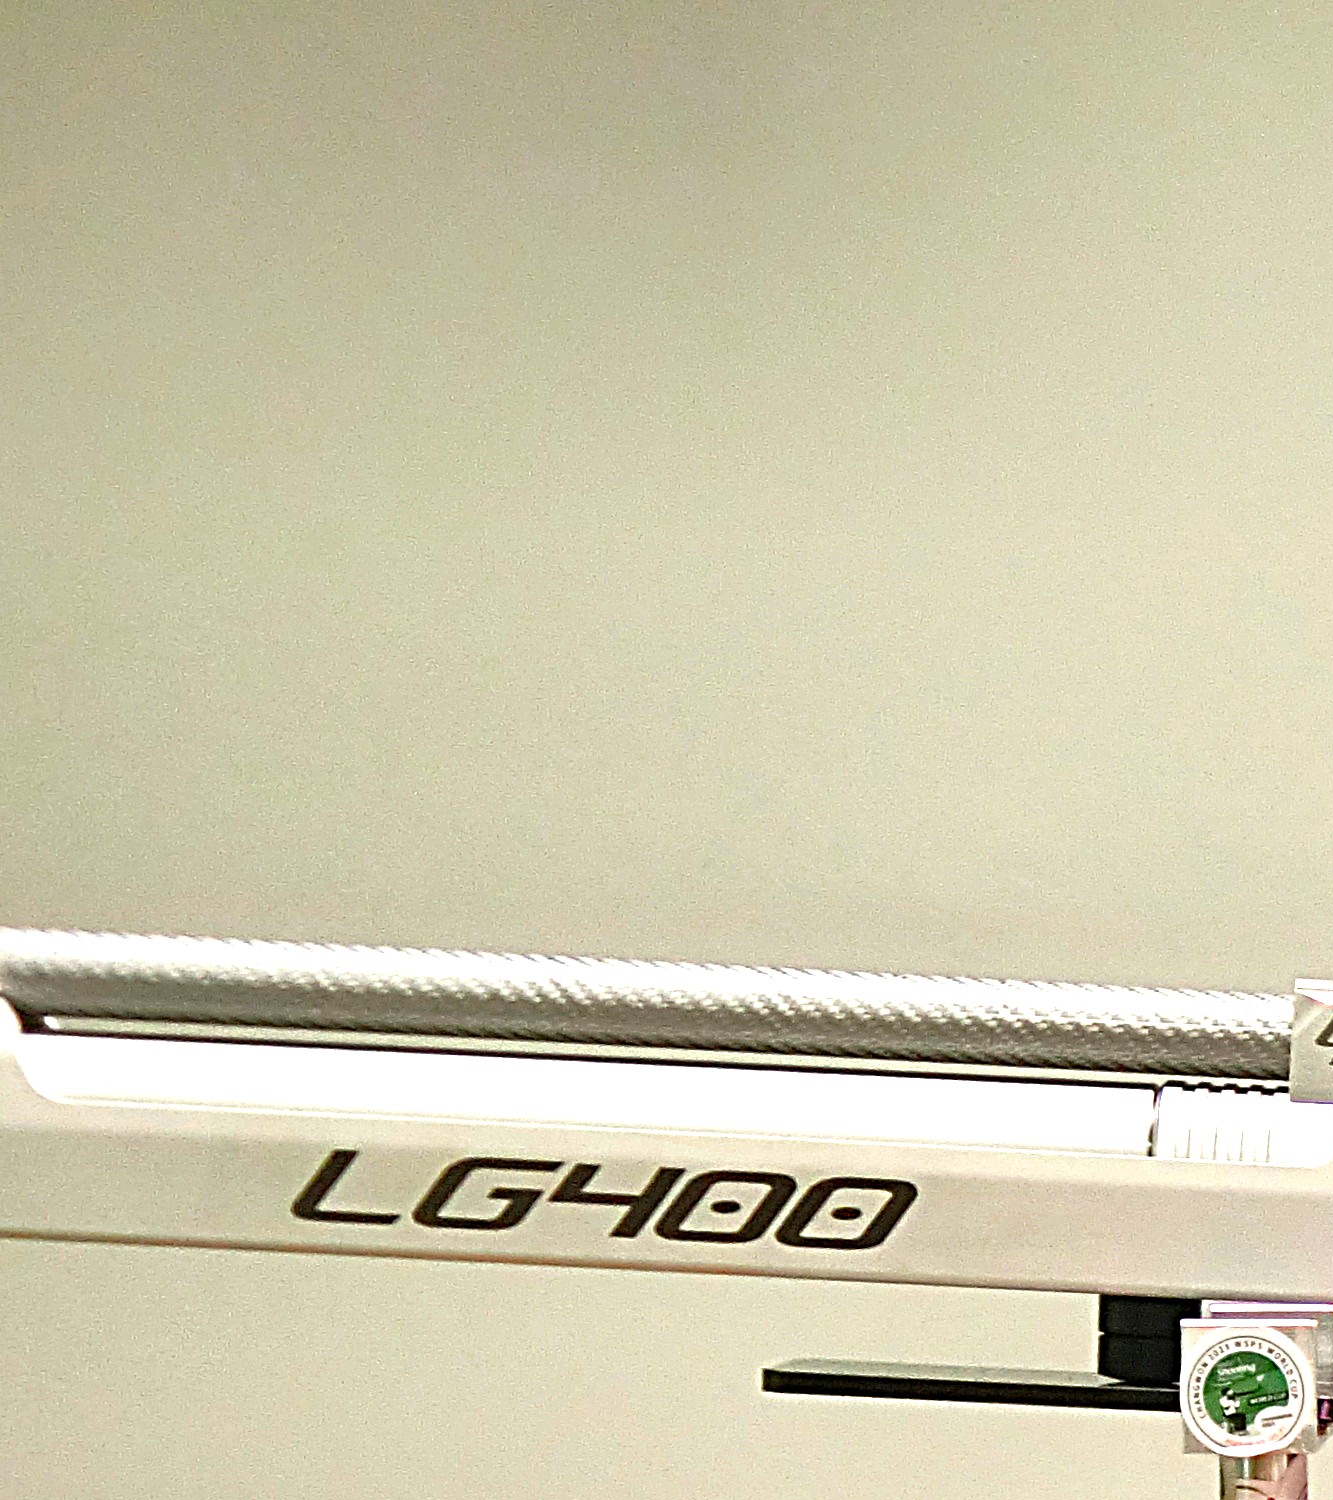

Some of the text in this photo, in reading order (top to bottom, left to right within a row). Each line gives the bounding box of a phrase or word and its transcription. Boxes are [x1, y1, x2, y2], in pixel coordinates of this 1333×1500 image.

[290, 1148, 919, 1250] LG400
[1267, 1345, 1294, 1376] WORLD
[1289, 1379, 1299, 1400] CUP
